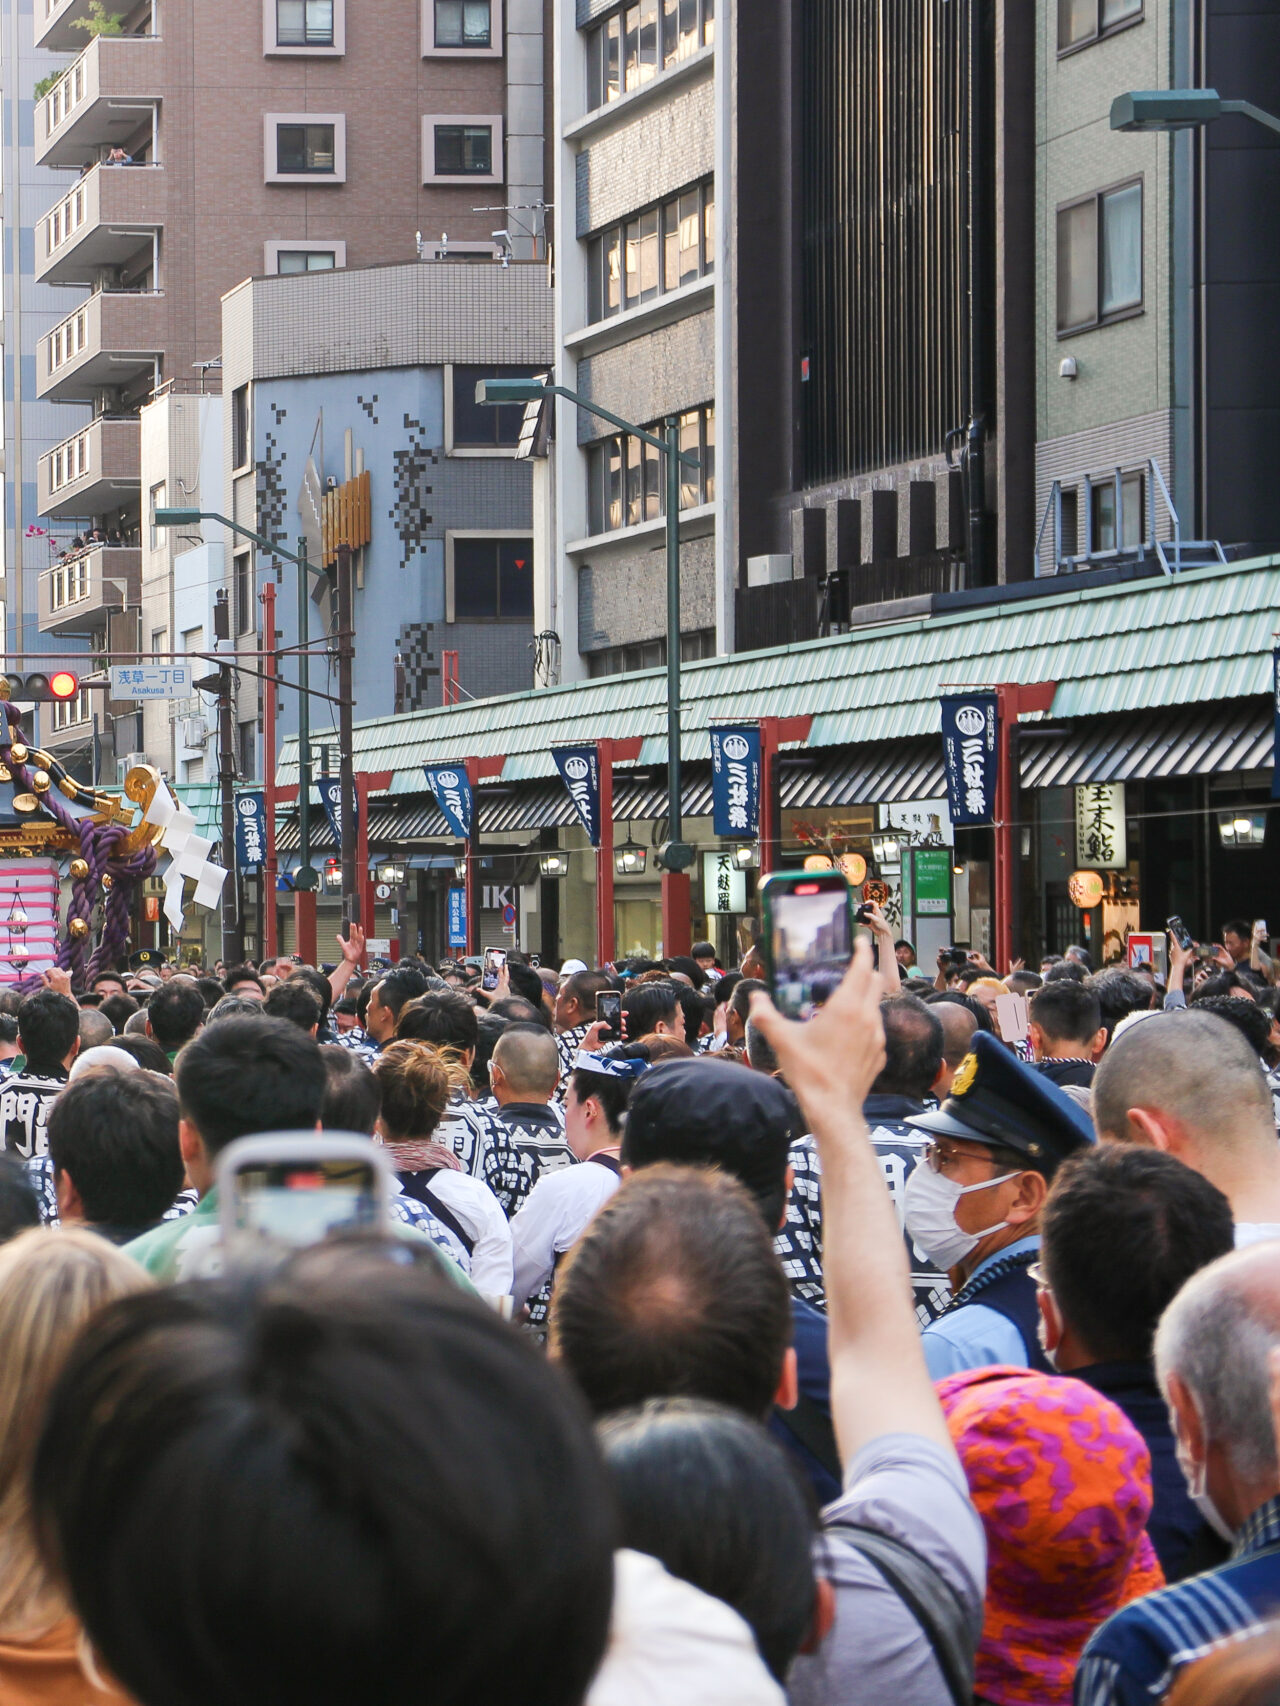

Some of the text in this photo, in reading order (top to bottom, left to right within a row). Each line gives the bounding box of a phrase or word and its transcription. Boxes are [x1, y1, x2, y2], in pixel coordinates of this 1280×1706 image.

[118, 670, 185, 685] 浅草一丁目
[132, 686, 174, 695] Asakusa 1
[960, 738, 986, 815] 三社祭
